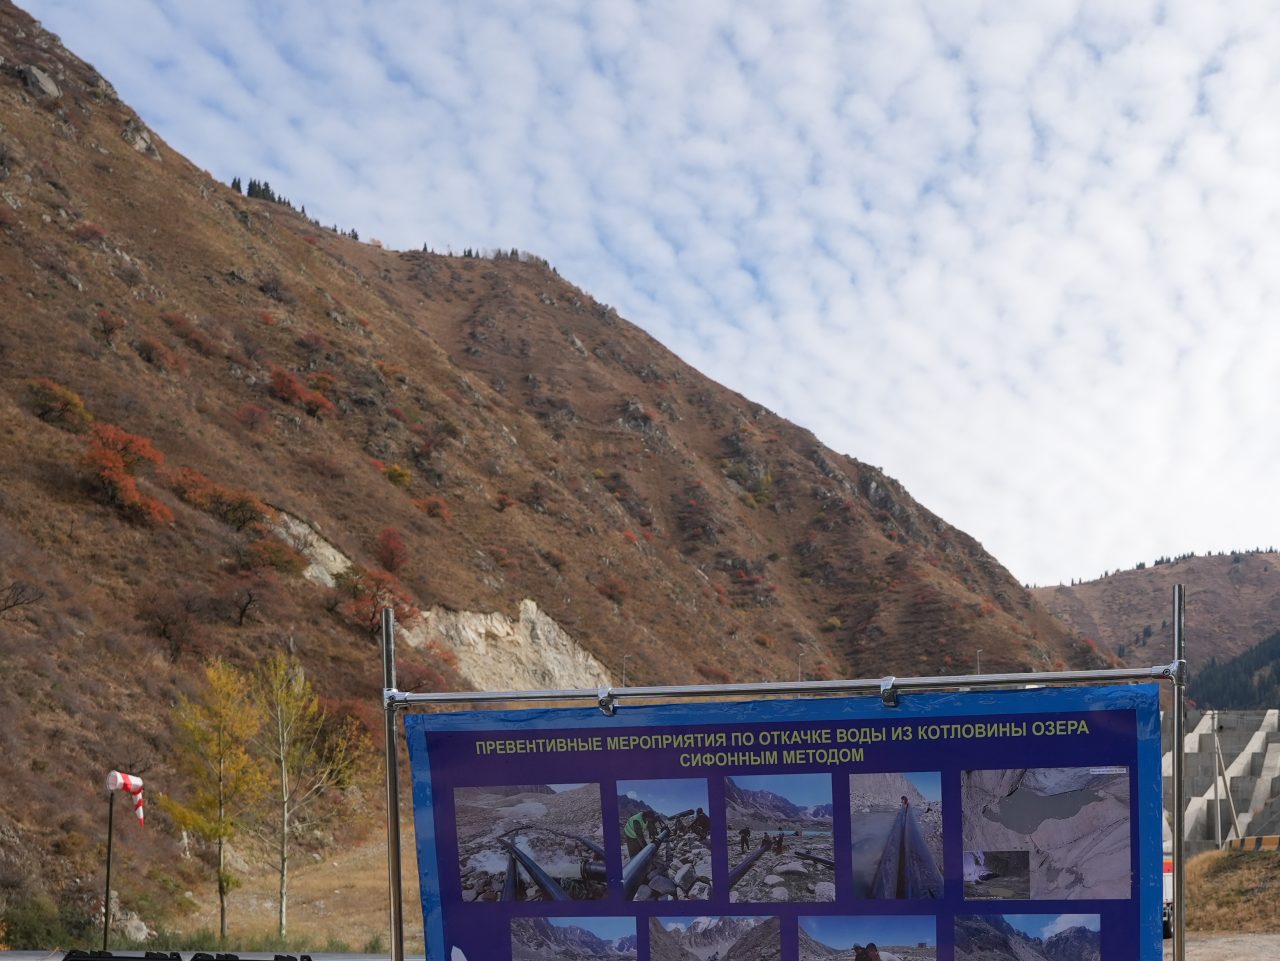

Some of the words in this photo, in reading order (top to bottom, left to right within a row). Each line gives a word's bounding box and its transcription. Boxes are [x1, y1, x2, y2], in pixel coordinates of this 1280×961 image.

[475, 737, 603, 755] ПРЕВЕНТИВНЫЕ
[606, 732, 727, 751] МЕРОПРИЯТИЯ
[731, 731, 754, 747] ПО
[758, 729, 832, 746] ОТКАЧКЕ
[836, 727, 887, 744] ВОДЫ
[891, 725, 913, 741] ИЗ
[918, 722, 1027, 740] КОТЛОВИНЫ
[1031, 719, 1090, 737] ОЗЕРА
[679, 751, 778, 768] СИФОННЫМ
[782, 748, 864, 766] МЕТОДОМ
